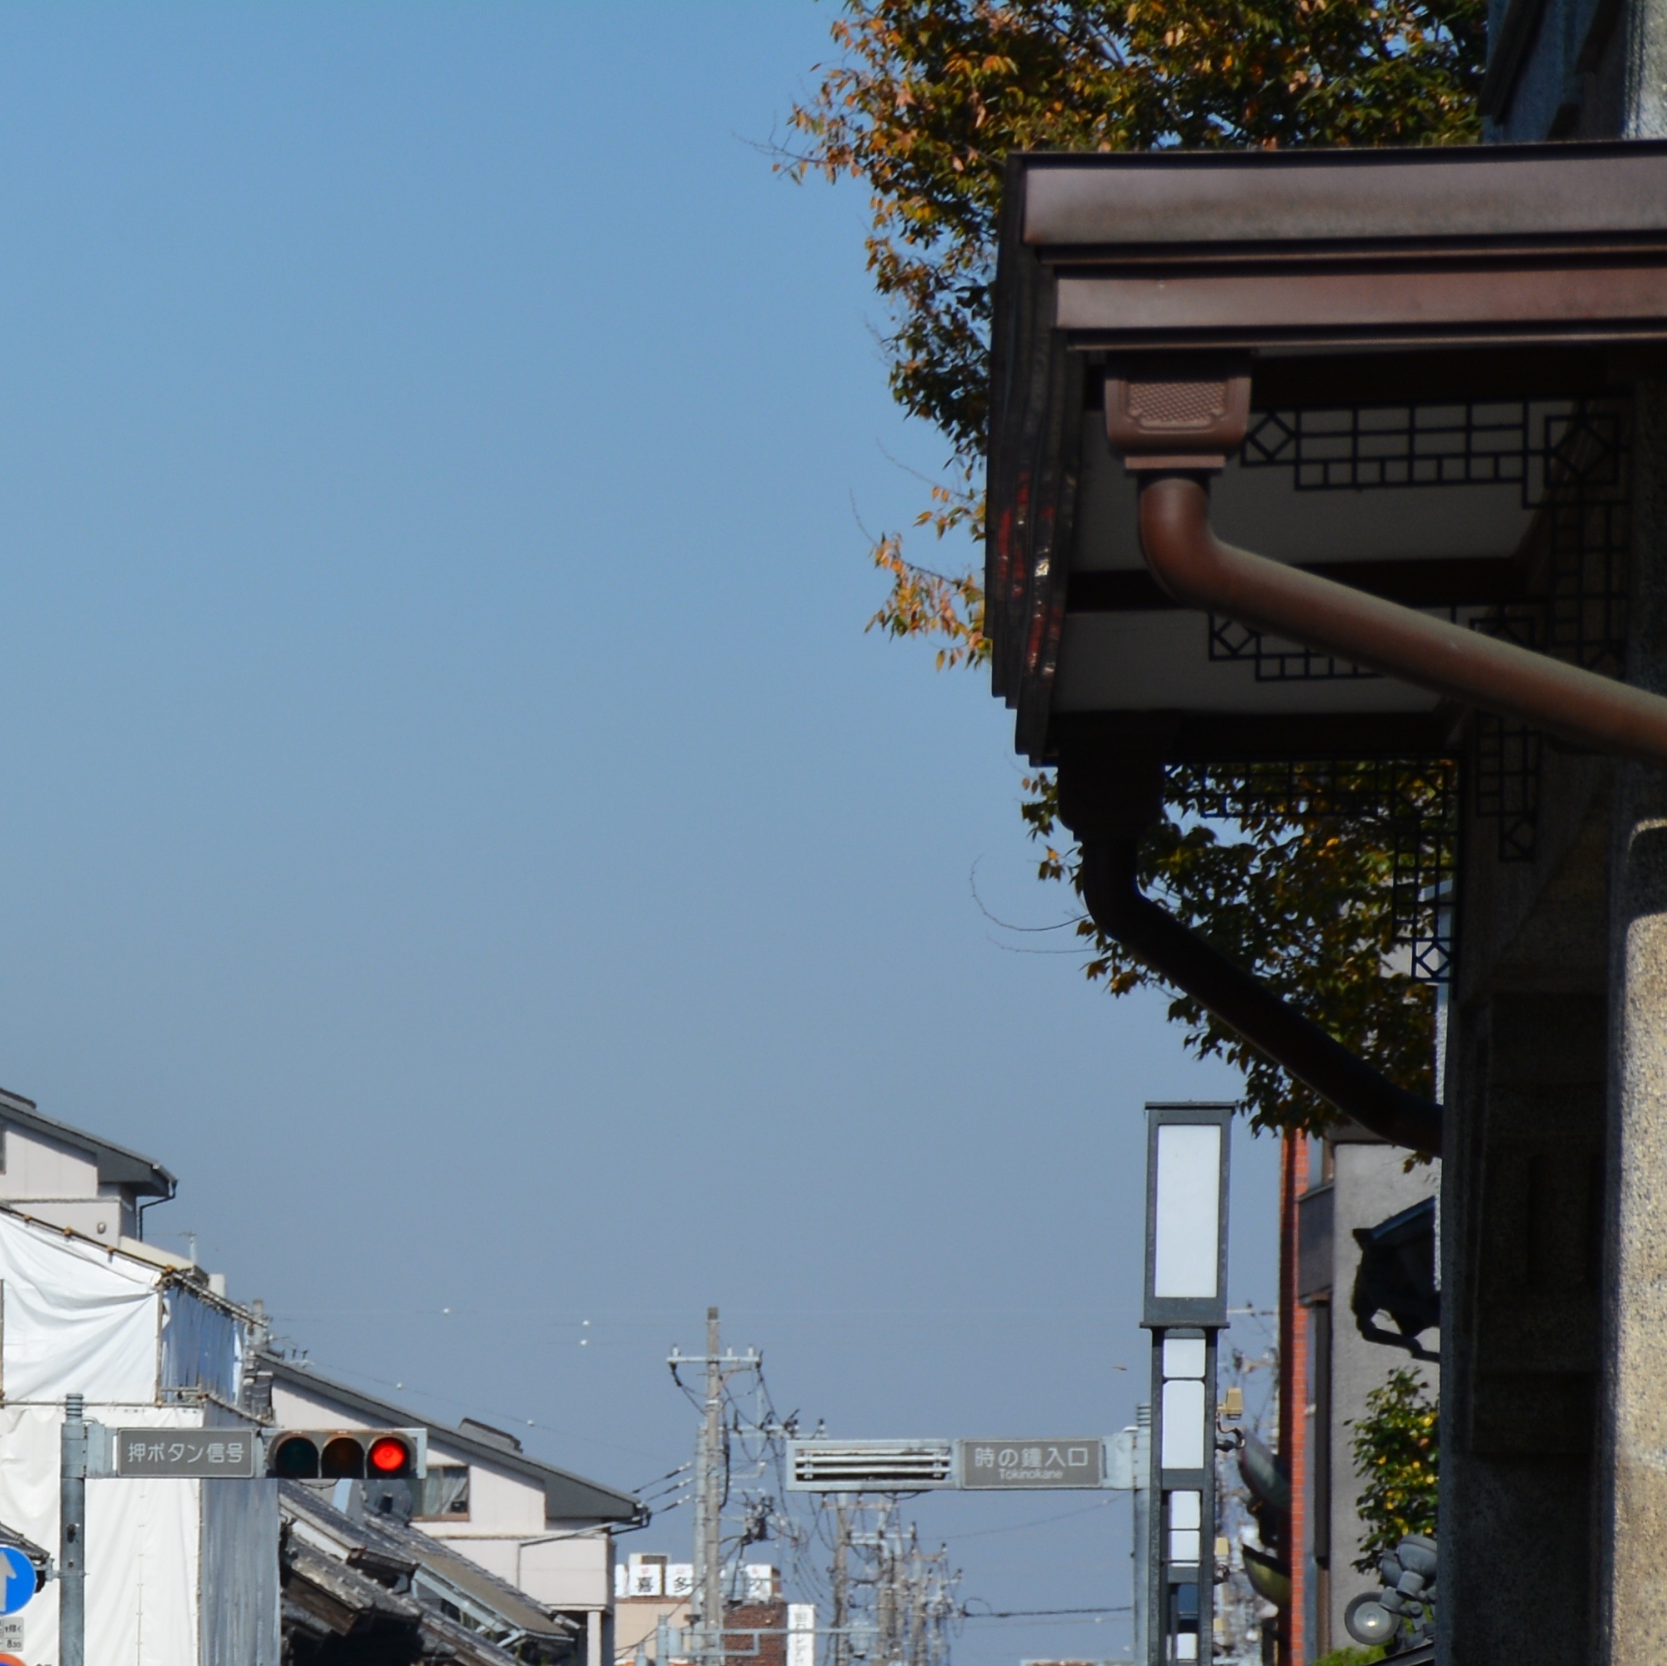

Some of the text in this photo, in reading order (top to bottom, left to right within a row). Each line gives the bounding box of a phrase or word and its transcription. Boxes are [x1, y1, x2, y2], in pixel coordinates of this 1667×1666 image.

[127, 1442, 245, 1464] 押ボタン信号
[973, 1447, 1089, 1468] 時の鐘入口
[998, 1468, 1063, 1480] Tokinokane
